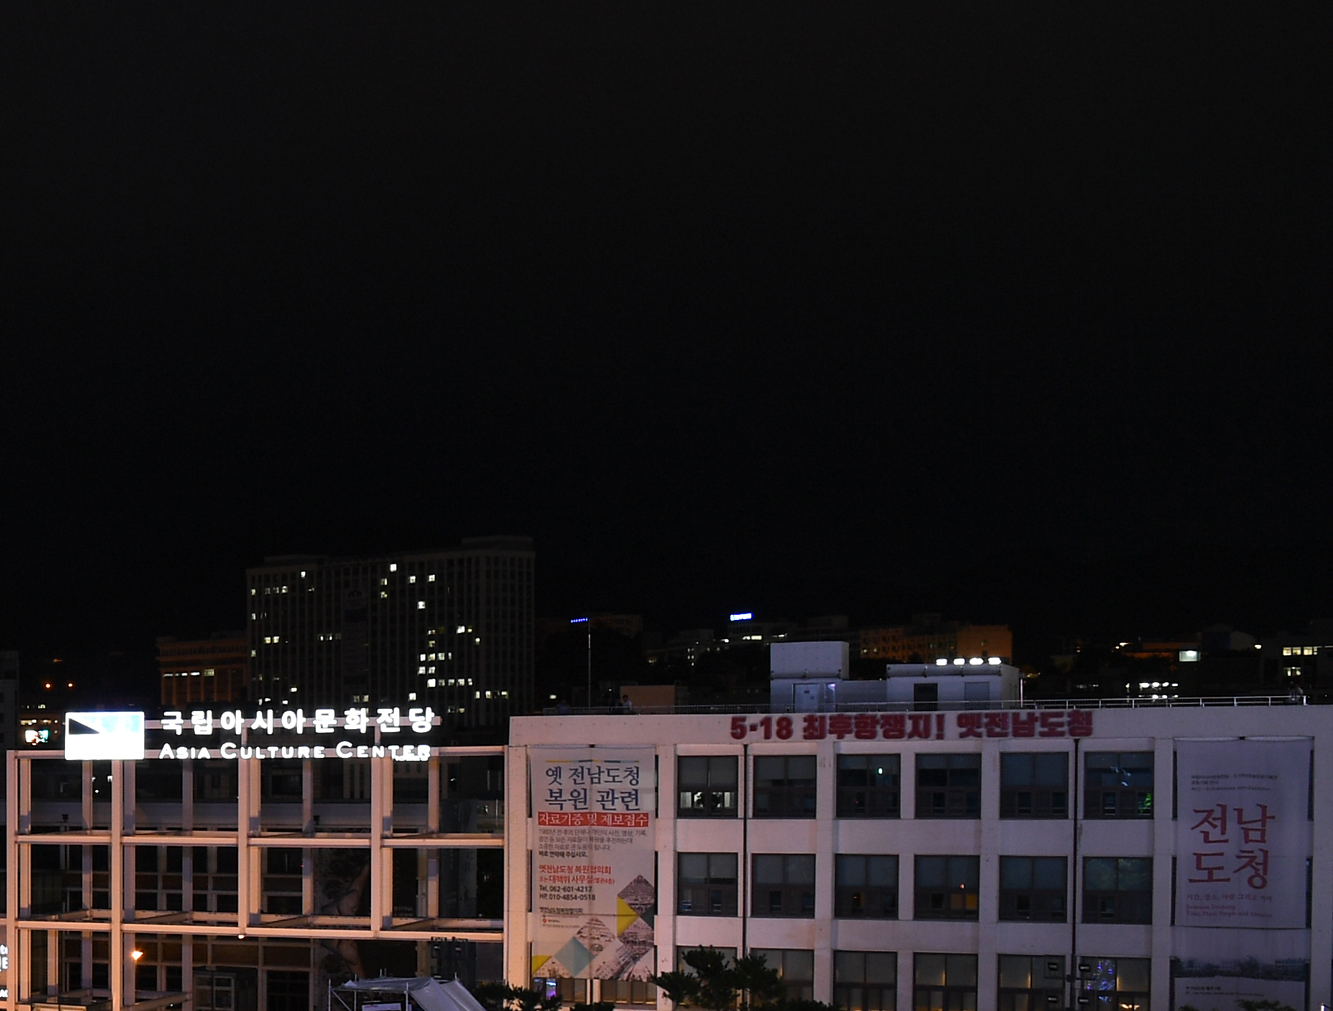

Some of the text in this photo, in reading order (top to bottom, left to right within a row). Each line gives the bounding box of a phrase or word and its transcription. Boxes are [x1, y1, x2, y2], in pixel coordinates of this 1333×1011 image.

[160, 708, 435, 735] 국립아시아문화전당
[802, 713, 945, 740] 최후항쟁지!
[957, 710, 1093, 739] 옛전남도청
[545, 766, 640, 786] 옛 전남도청
[544, 788, 641, 811] 복원 관련
[539, 813, 648, 826] 자료기증 및 제보접수
[1191, 803, 1275, 844] 전남
[1188, 849, 1269, 889] 도청
